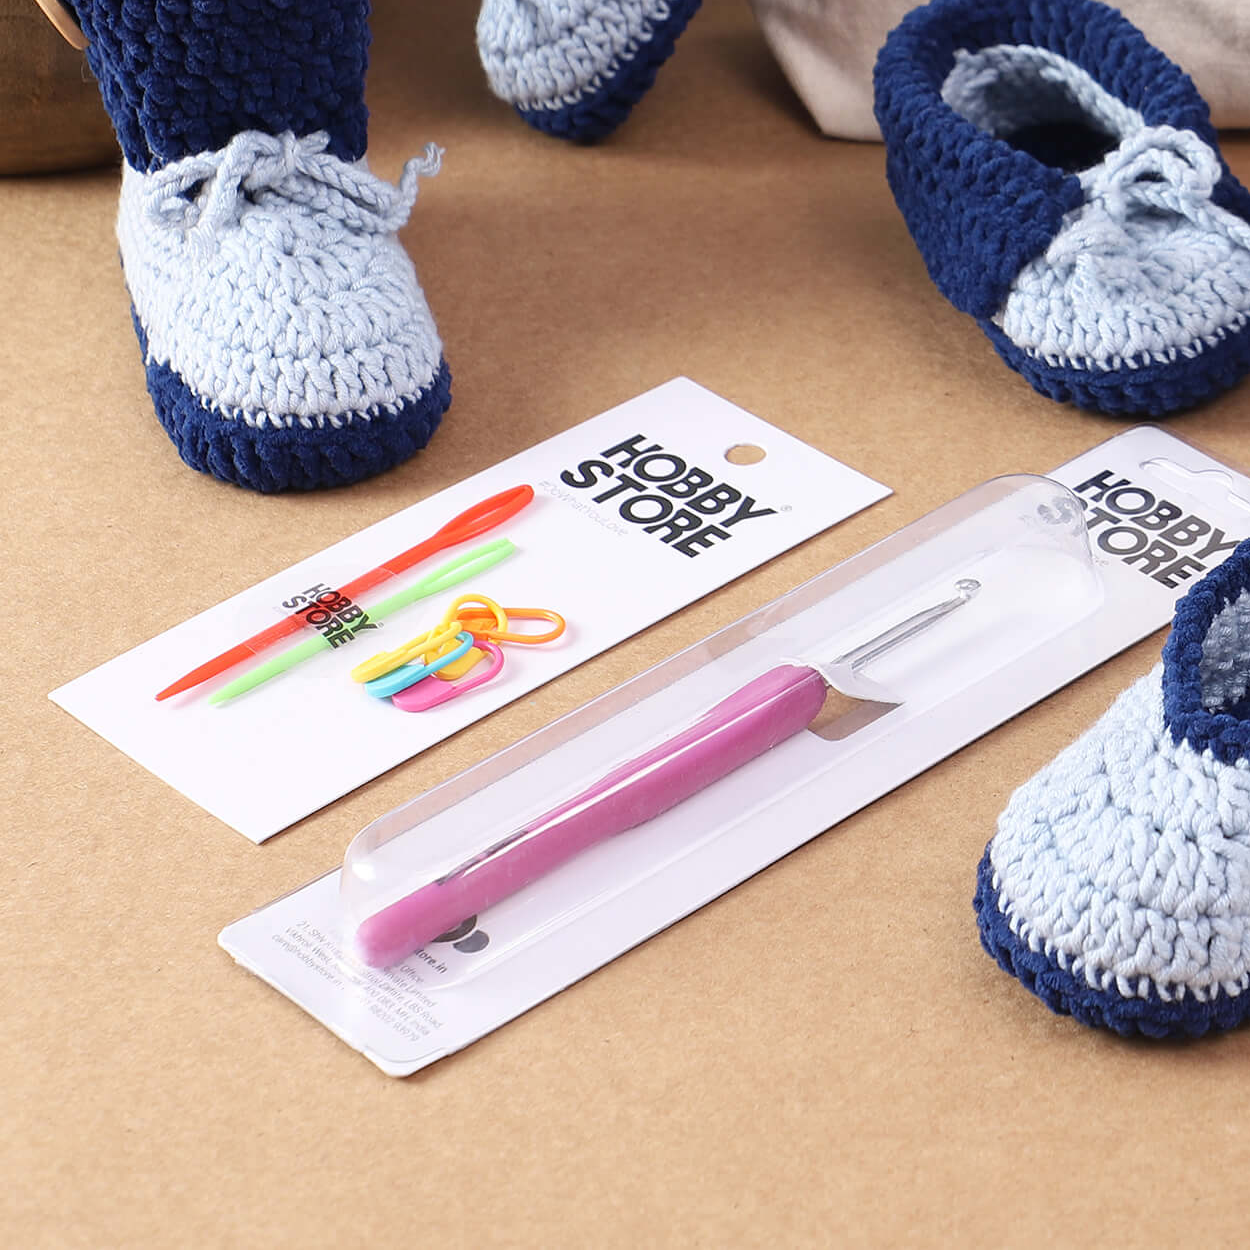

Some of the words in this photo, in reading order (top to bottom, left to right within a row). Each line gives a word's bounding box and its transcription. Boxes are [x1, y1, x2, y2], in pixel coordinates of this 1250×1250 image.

[560, 460, 732, 558] STORE
[600, 434, 778, 528] HOBBY
[1073, 469, 1241, 560] HOBBY
[282, 596, 355, 649] STORE
[303, 583, 378, 634] HOBBY
